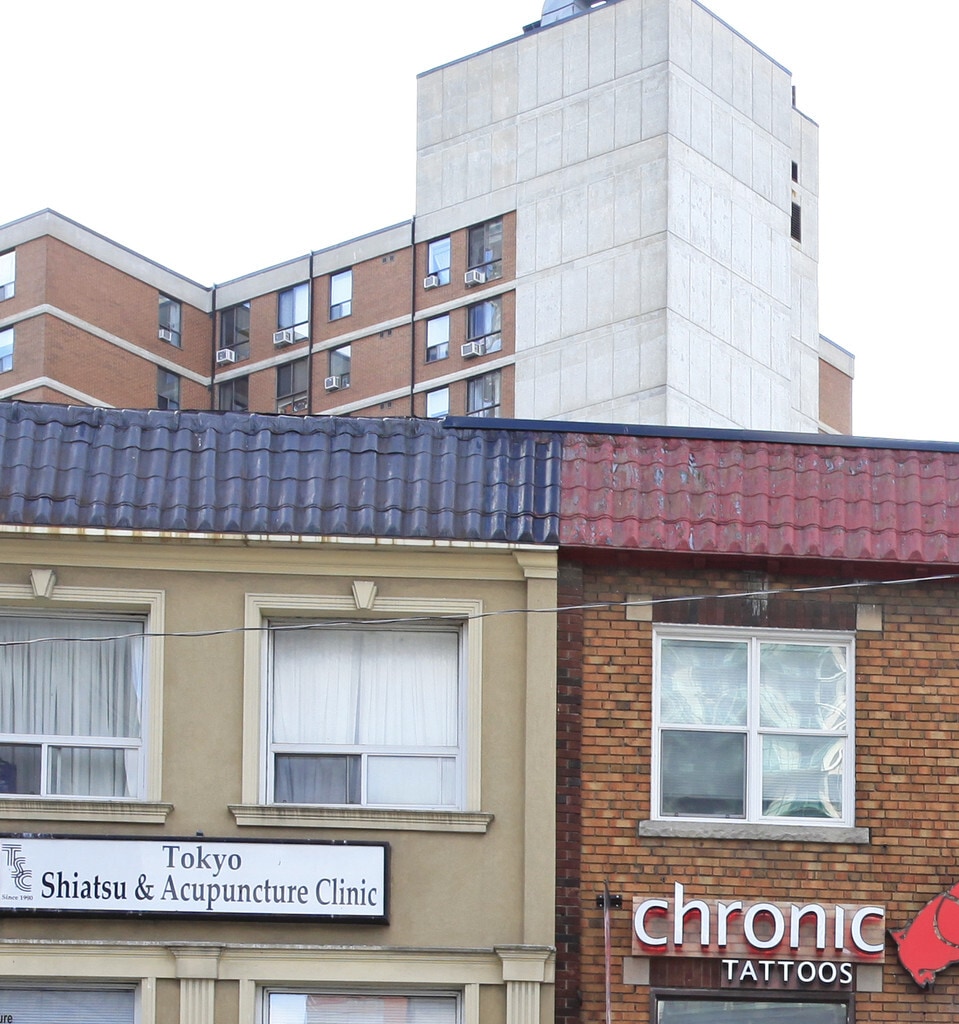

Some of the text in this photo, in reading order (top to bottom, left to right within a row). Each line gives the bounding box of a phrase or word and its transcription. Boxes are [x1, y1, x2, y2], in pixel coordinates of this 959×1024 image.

[162, 845, 242, 877] Tokyo
[41, 871, 377, 910] Shiatsu & Acupuncture Clinic
[634, 881, 885, 953] chronic
[722, 959, 852, 984] TATTOOS
